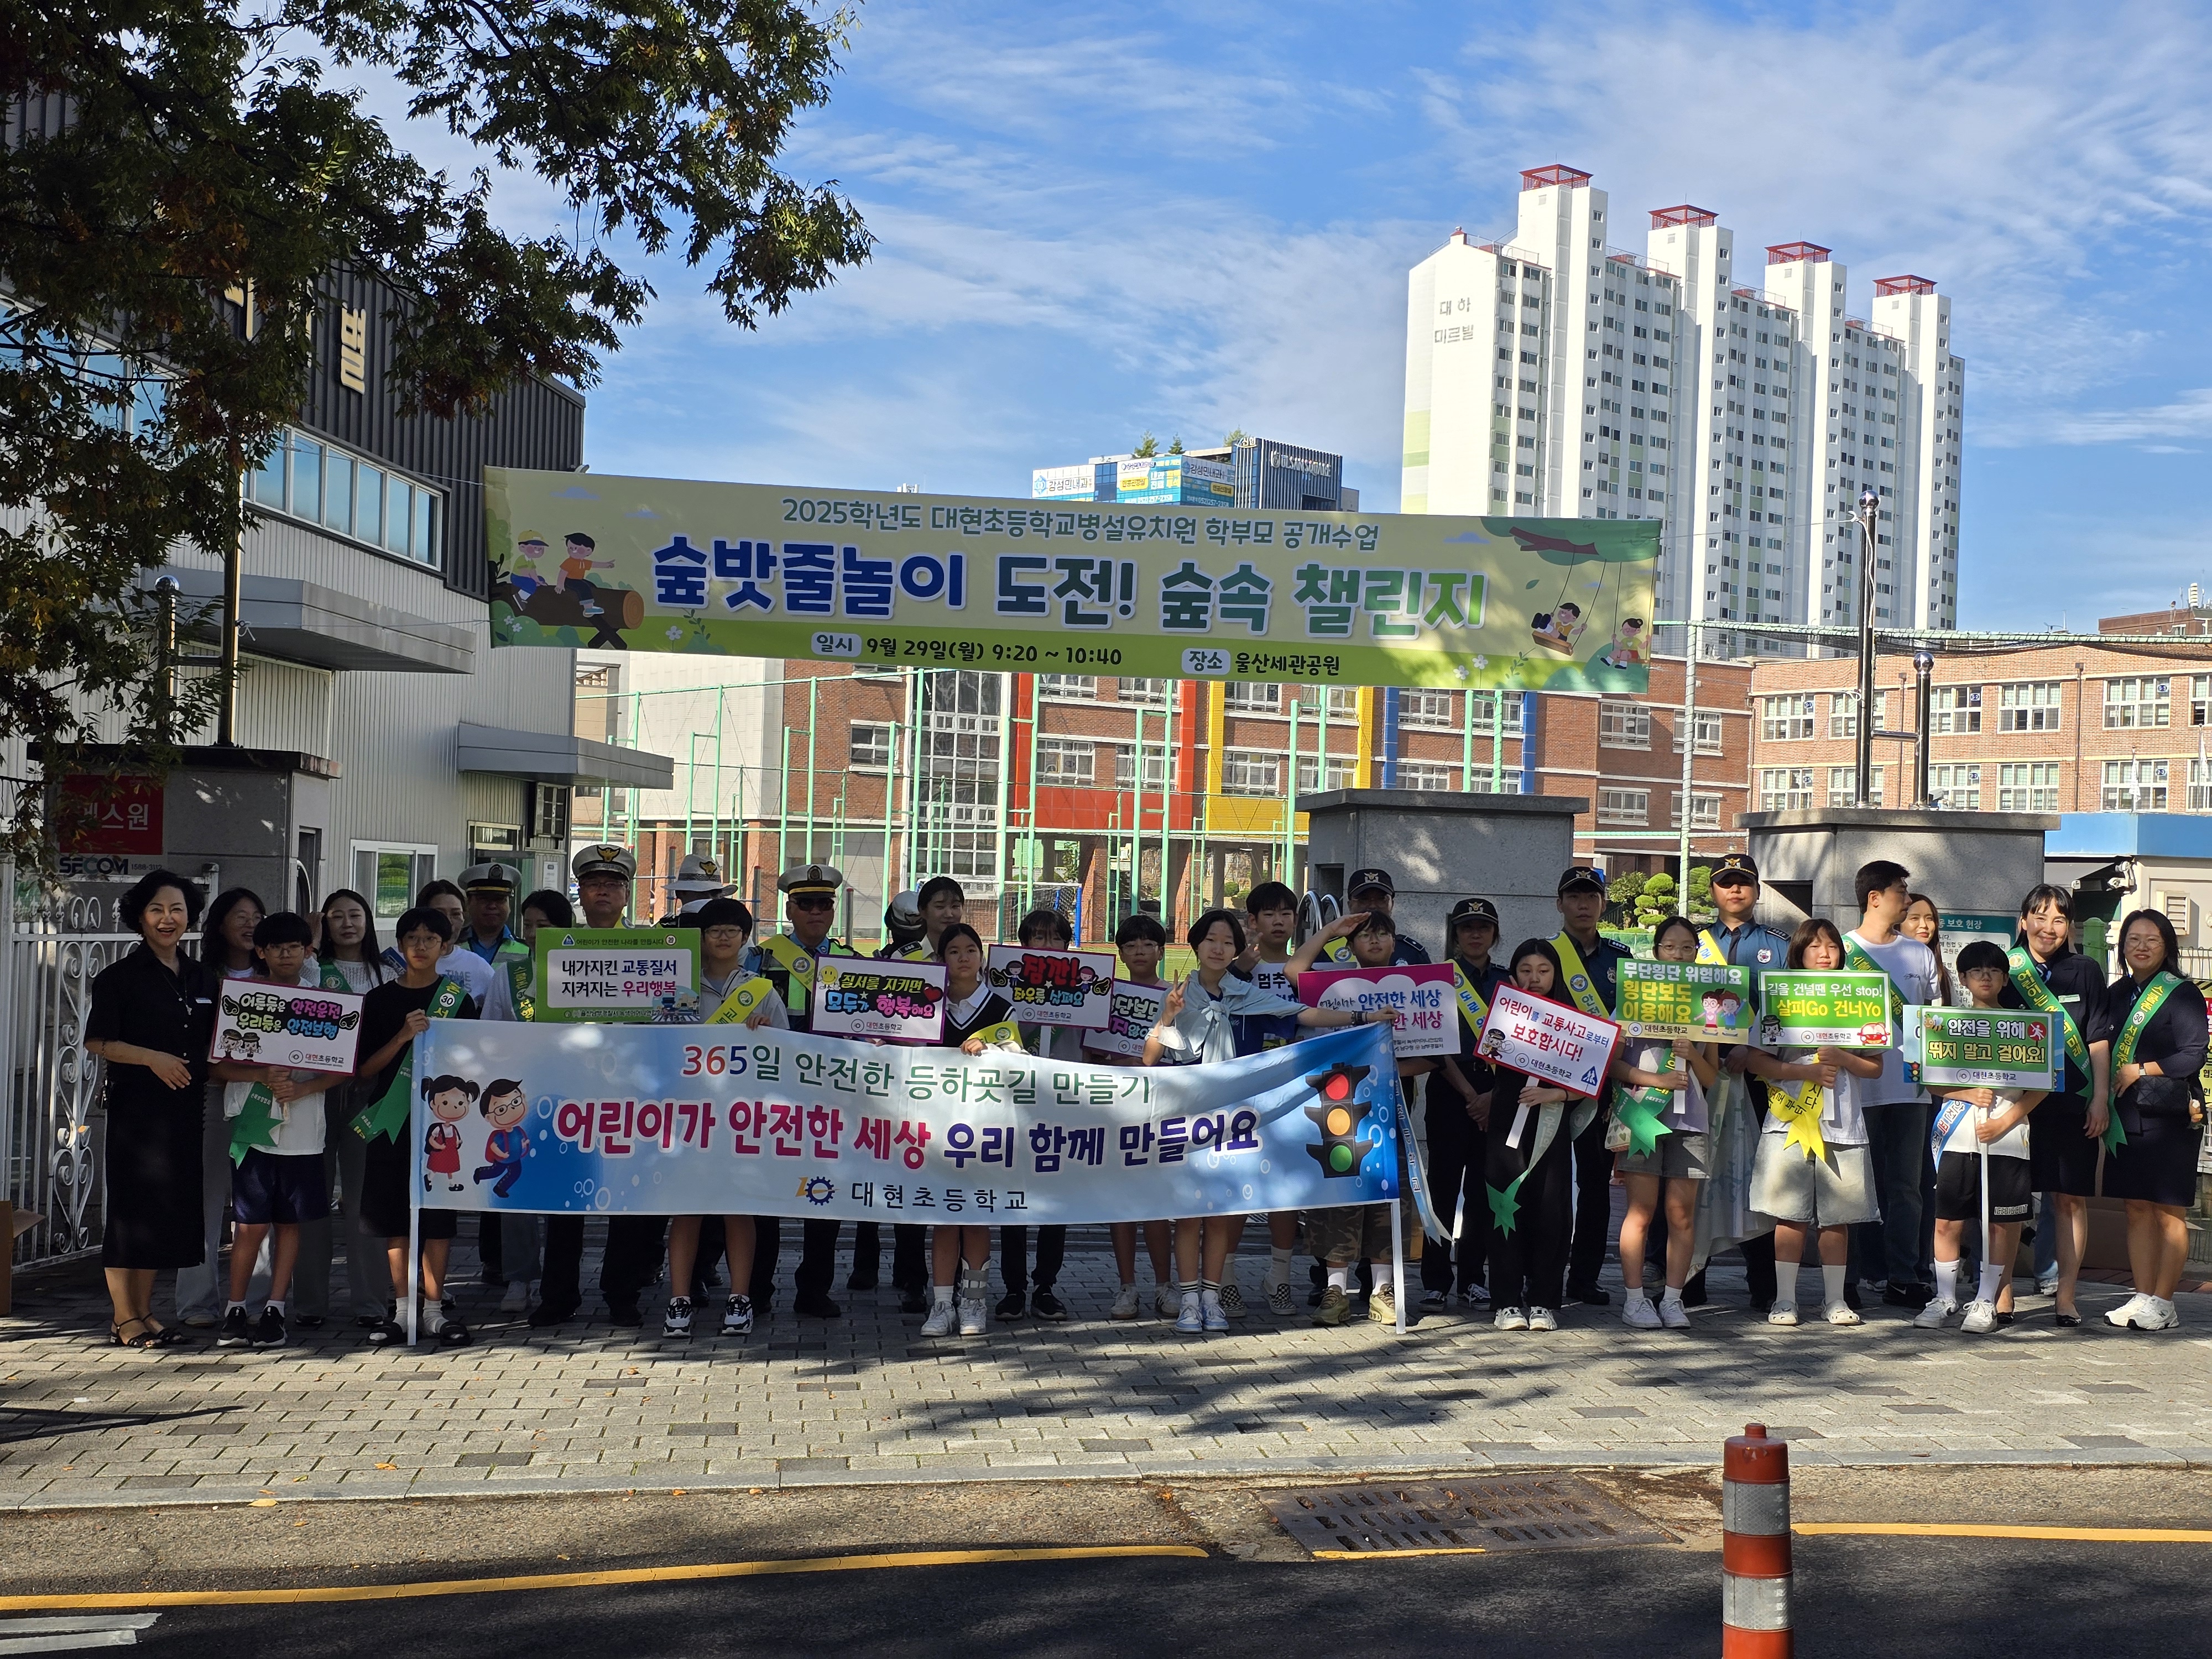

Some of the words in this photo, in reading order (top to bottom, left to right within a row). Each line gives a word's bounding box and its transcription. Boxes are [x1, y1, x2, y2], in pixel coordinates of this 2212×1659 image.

[1190, 463, 1222, 479] 강성민내과
[782, 498, 922, 530] 2025학년도
[931, 503, 1197, 545] 대현초등학교병설유치원
[1207, 515, 1274, 546] 학부모
[1284, 521, 1379, 552] 공개수업
[654, 534, 965, 618] 숲밧줄놀이
[995, 555, 1134, 628] 도전!
[1159, 560, 1272, 634] 숲속
[1292, 563, 1488, 638] 챌린지
[816, 634, 854, 653] 일시
[867, 637, 898, 656] 9월
[903, 638, 984, 661] 29일(월)
[992, 644, 1038, 661] 9:20
[1066, 646, 1121, 665] 10:40
[1188, 651, 1223, 672] 장소
[1235, 653, 1340, 676] 울산세관공원
[1966, 920, 1983, 930] 헌장
[562, 959, 618, 977] 내가지킨
[621, 959, 677, 976] 교통질서
[1022, 954, 1079, 988] 잠깐!
[1624, 962, 1681, 981] 무단횡단
[1685, 965, 1742, 985] 위험해요
[561, 980, 618, 997] 지켜지는
[621, 980, 677, 997] 우리행복
[840, 974, 880, 990] 질서를
[881, 977, 924, 994] 지키면
[1623, 980, 1692, 1003] 횡단보도
[1767, 983, 1790, 997] 길을
[1793, 982, 1827, 997] 건널땐
[1829, 983, 1852, 997] 우선
[1855, 984, 1883, 998] stop!
[240, 994, 286, 1013] 어른들은
[290, 999, 342, 1019] 안전운전
[441, 995, 453, 1005] 30
[827, 992, 870, 1013] 모두가
[876, 994, 936, 1018] 행복해요
[1014, 987, 1046, 1003] 좌우를
[1050, 988, 1084, 1006] 살펴요
[1319, 997, 1356, 1010] 어린이가
[1358, 990, 1407, 1011] 안전한
[1410, 988, 1443, 1009] 세상
[2140, 985, 2164, 1012] 스쿨존
[1036, 1010, 1072, 1020] 대현초등학교
[1623, 1001, 1691, 1024] 이용해요
[1777, 999, 1828, 1018] 살피Go
[1833, 1000, 1881, 1018] 건너Yo
[2134, 1014, 2143, 1022] 30
[238, 1013, 281, 1031] 우리들은
[286, 1018, 337, 1039] 안전보행
[866, 1021, 902, 1031] 대현초등학교
[1411, 1010, 1443, 1030] 세상
[1499, 996, 1540, 1023] 어린이를
[1541, 1012, 1610, 1048] 교통사고로부터
[1644, 1024, 1688, 1034] 대현초등학교
[1948, 1018, 1991, 1038] 안전을
[1996, 1020, 2026, 1040] 위해
[1510, 1023, 1584, 1062] 보호합시다!
[1928, 1041, 1957, 1060] 뛰지
[1963, 1042, 1993, 1061] 말고
[1997, 1045, 2045, 1064] 걸어요!
[305, 1053, 344, 1064] 대현초등학교
[1530, 1058, 1572, 1079] 대현초등학교
[682, 1045, 780, 1082] 365일
[795, 1052, 894, 1098] 안전한
[904, 1066, 1037, 1105] 등하굣길
[1052, 1070, 1150, 1104] 만들기
[1972, 1071, 2017, 1081] 대현초등학교
[557, 1100, 716, 1156] 어린이가
[728, 1099, 844, 1160] 안전한
[854, 1114, 932, 1171] 세상
[943, 1122, 1014, 1170] 우리
[1028, 1122, 1105, 1173] 함께
[1119, 1110, 1259, 1167] 만들어요
